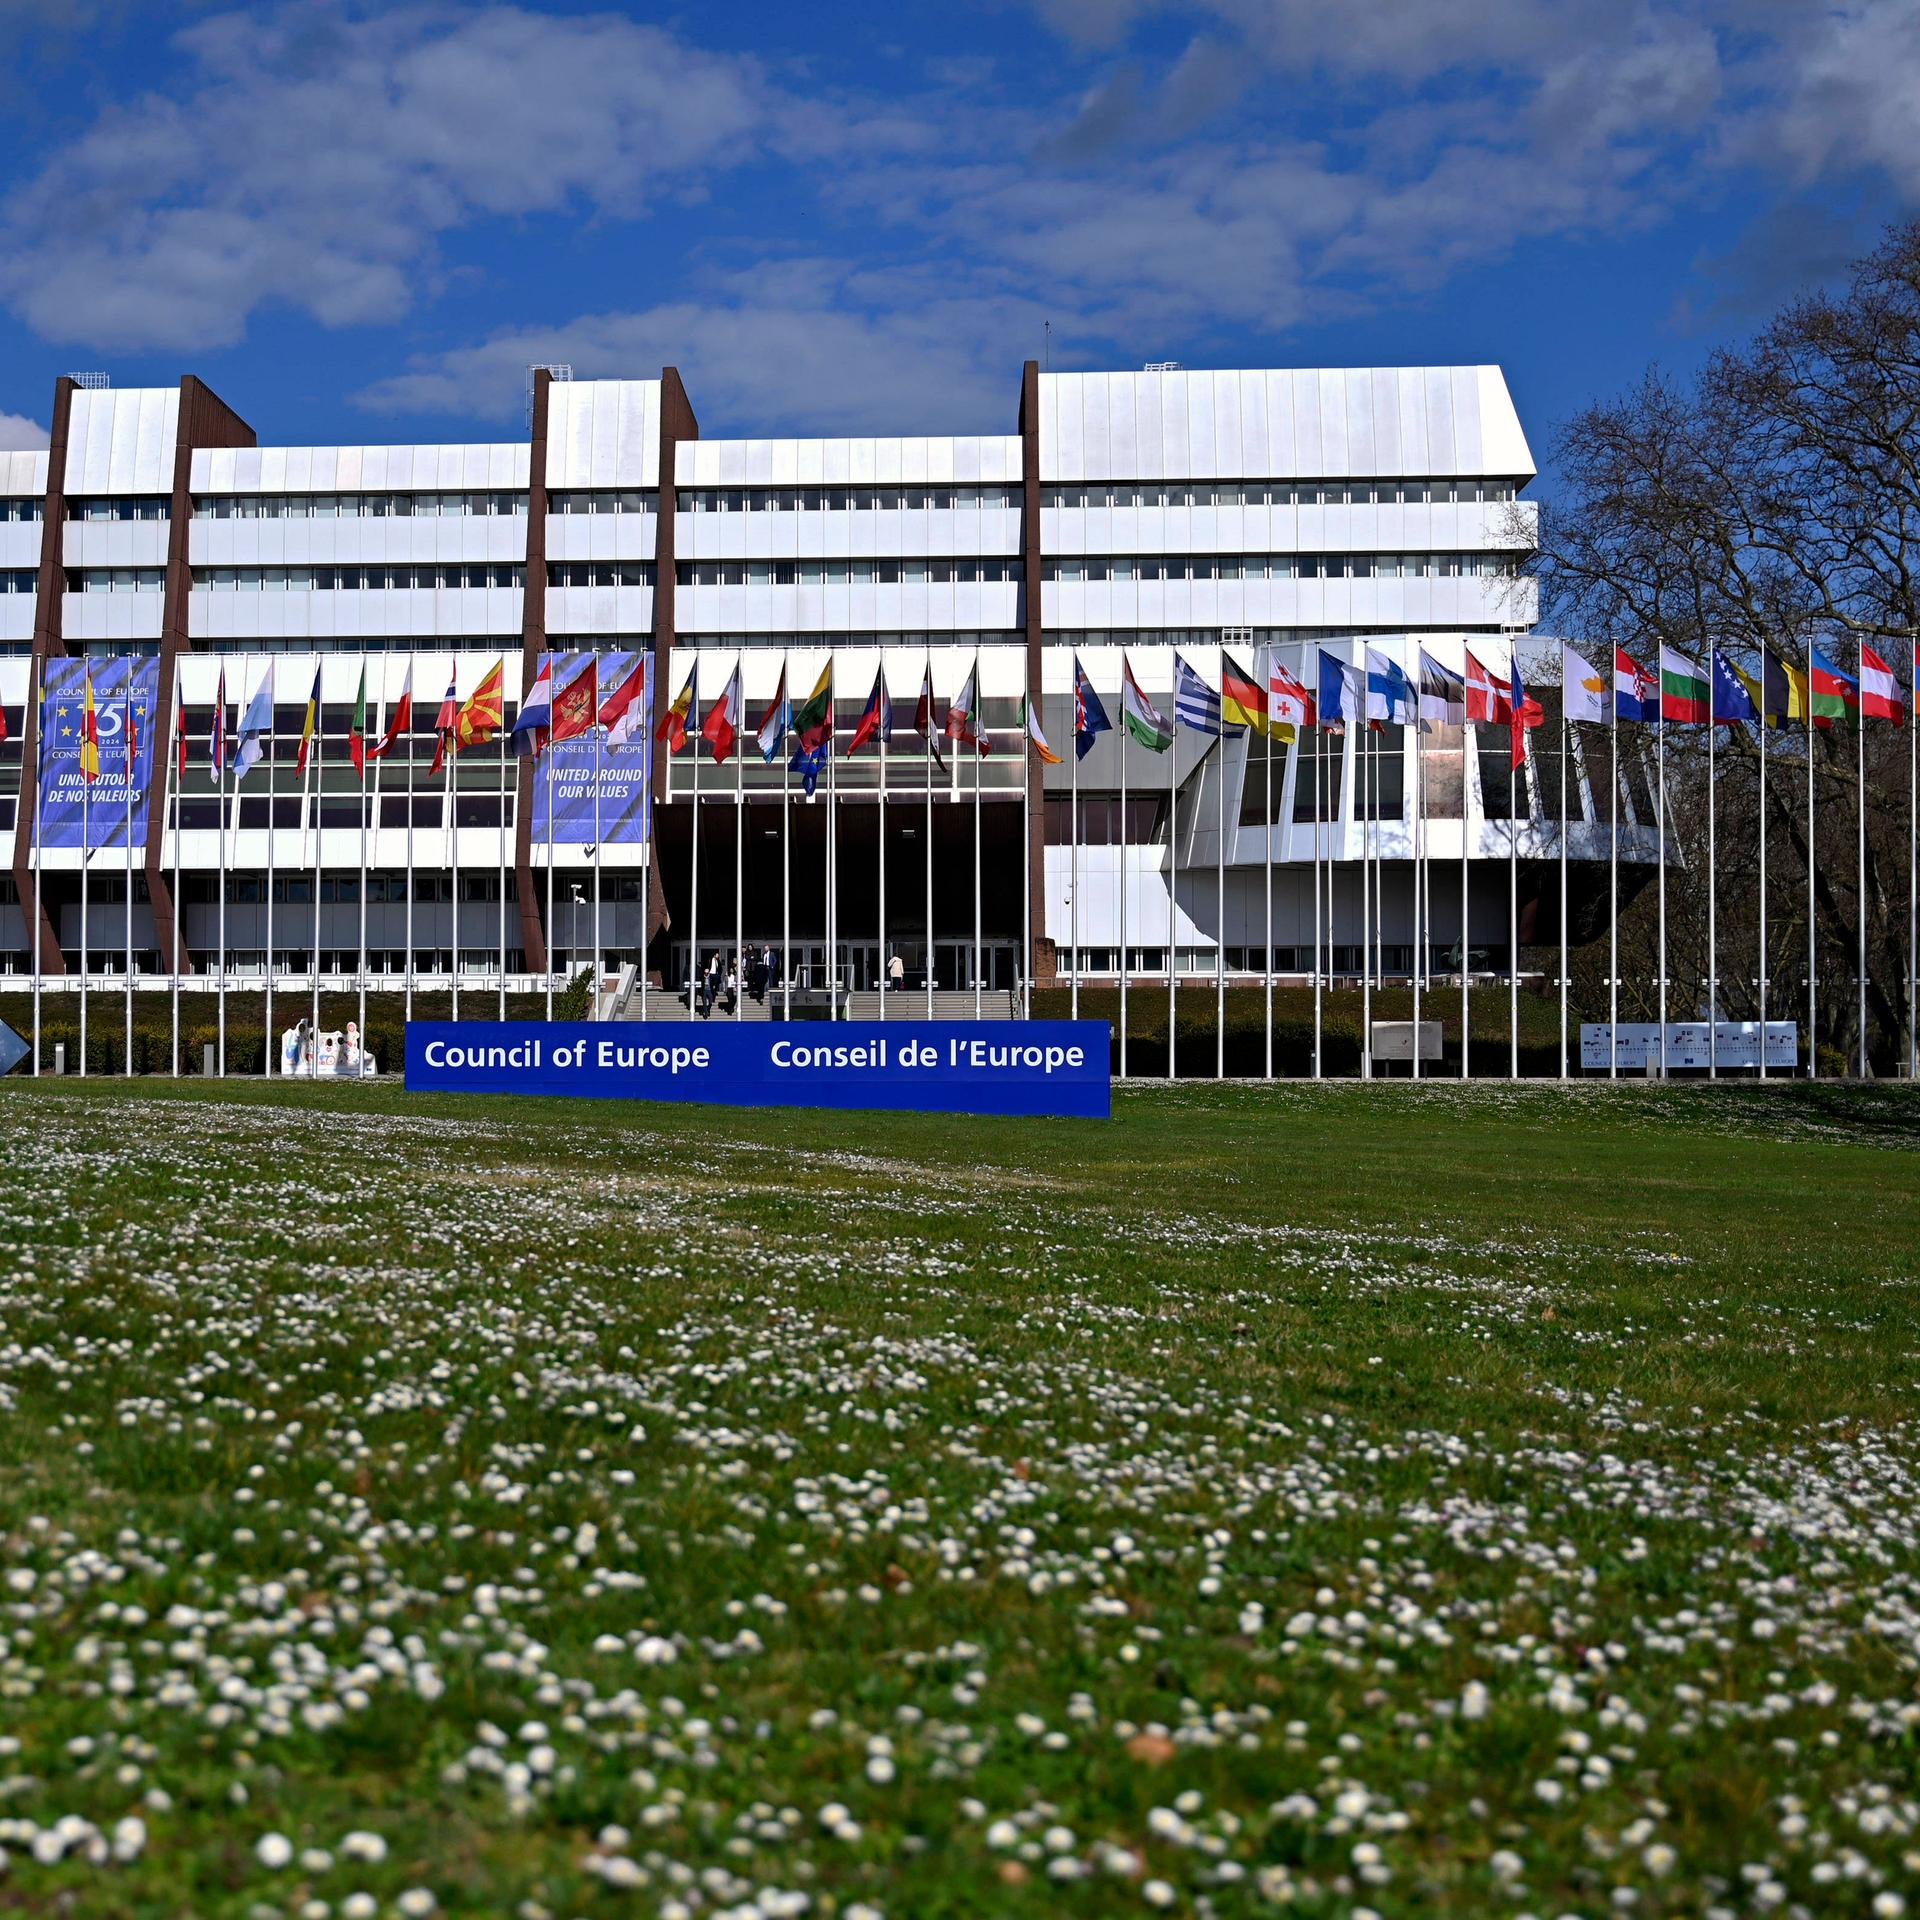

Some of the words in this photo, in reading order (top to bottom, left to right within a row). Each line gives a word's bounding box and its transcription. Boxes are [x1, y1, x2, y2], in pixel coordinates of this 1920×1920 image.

[101, 688, 113, 696] OF
[546, 768, 590, 782] UNITED
[48, 790, 65, 803] DE
[91, 789, 142, 803] VALEURS
[558, 785, 584, 798] OUR
[425, 1040, 541, 1068] Council
[552, 1040, 587, 1067] of
[598, 1041, 710, 1074] Europe
[771, 1039, 886, 1067] Conseil
[898, 1039, 938, 1067] de
[950, 1039, 1085, 1073] l'Europe
